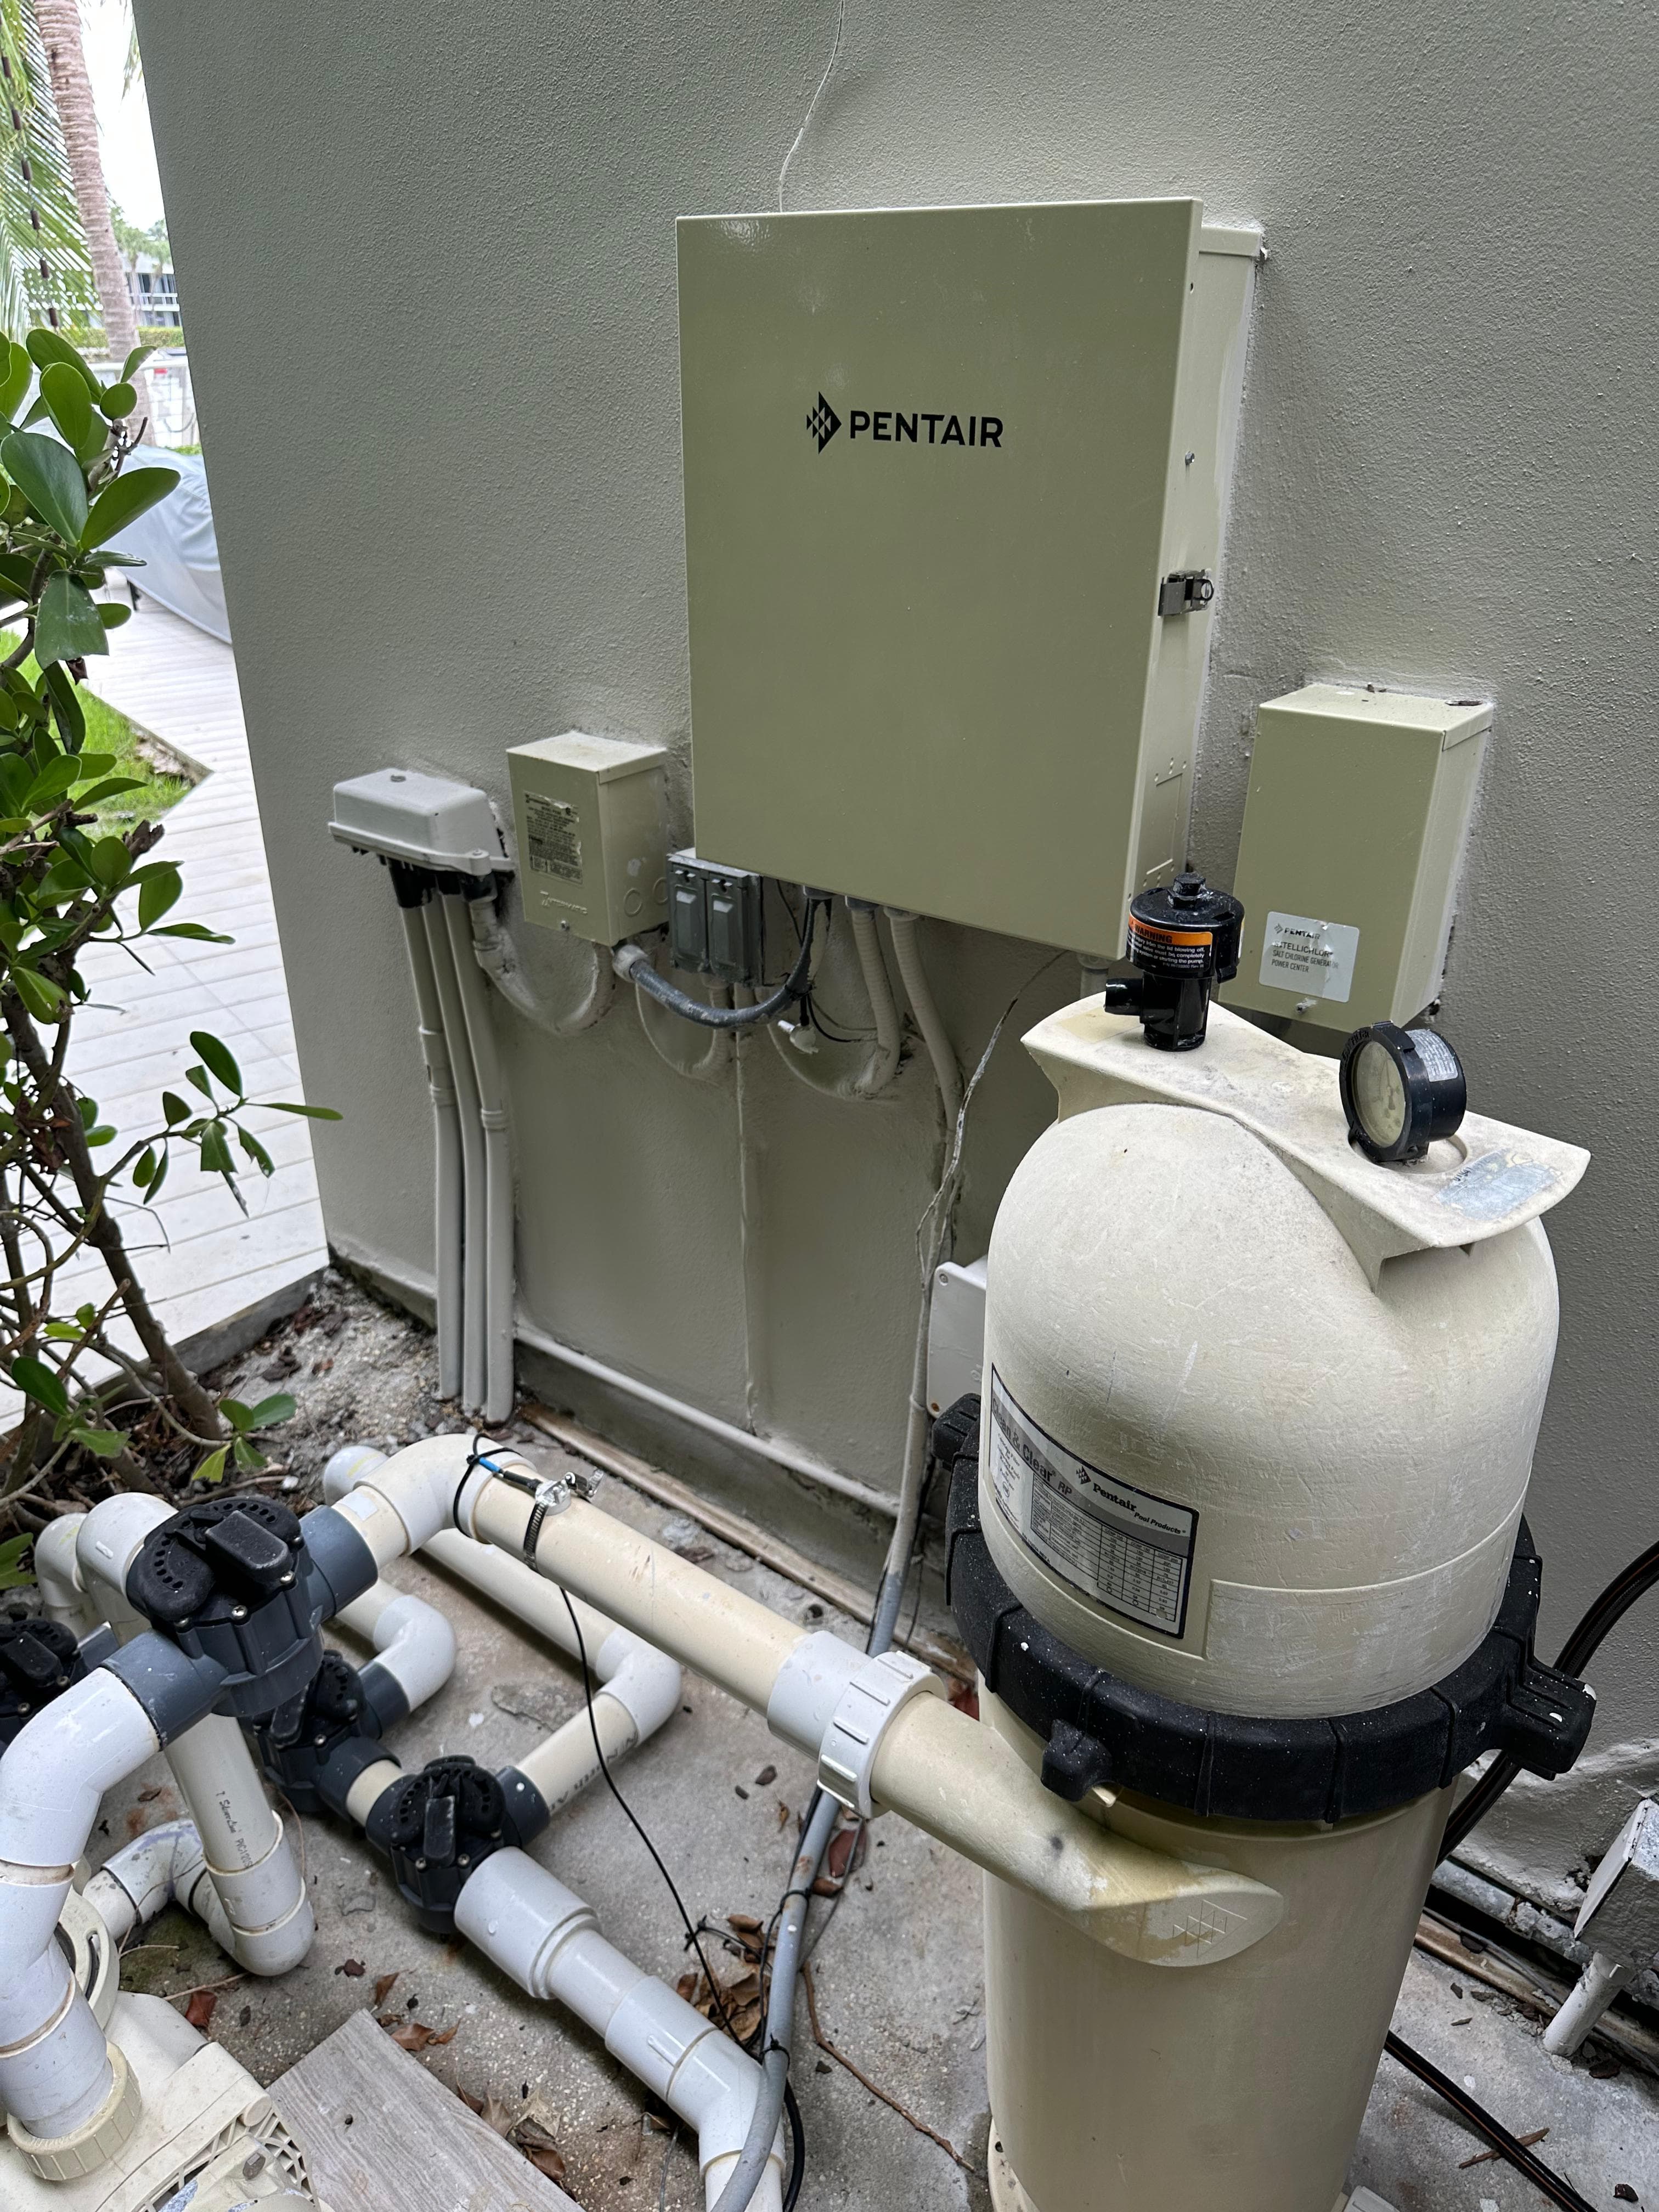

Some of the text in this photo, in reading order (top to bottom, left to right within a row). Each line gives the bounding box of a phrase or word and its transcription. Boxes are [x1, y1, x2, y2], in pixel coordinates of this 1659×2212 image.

[850, 410, 1003, 448] PENTAIR
[1135, 924, 1173, 944] WARNING
[1271, 958, 1309, 973] POWER CENTER
[1272, 950, 1284, 958] SALT
[1284, 952, 1309, 964] CHLORINE
[992, 1398, 1011, 1440] Clean
[1013, 1431, 1020, 1453] &
[1058, 1481, 1073, 1495] RP
[1092, 1482, 1137, 1513] Pentair
[1134, 1512, 1181, 1534] Pool Products
